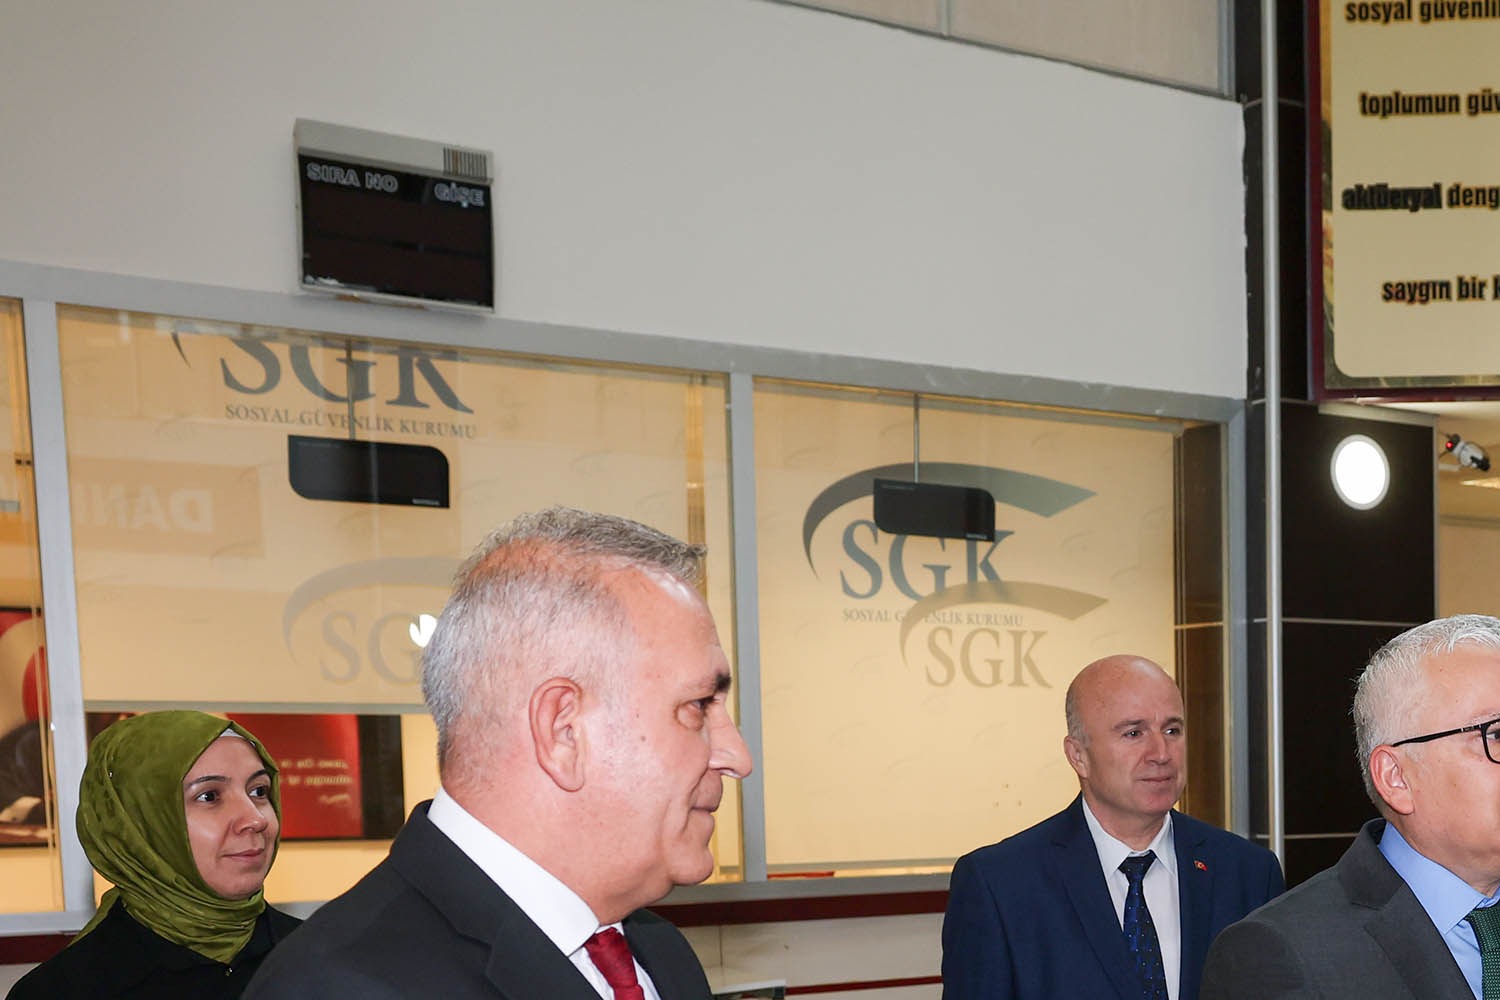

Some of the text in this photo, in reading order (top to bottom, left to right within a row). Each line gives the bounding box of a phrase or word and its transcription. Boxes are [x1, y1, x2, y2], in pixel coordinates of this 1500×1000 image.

[1346, 0, 1412, 24] sosyal
[1360, 92, 1460, 118] toplumun
[307, 162, 485, 208] SIRA NO GİŞE
[1342, 183, 1442, 213] aktüeryal
[1383, 279, 1452, 305] saygın
[1457, 276, 1487, 301] bir
[225, 404, 477, 440] SOSYAL GÜVENLİK KURUMU
[842, 608, 893, 624] SOSYAL
[966, 613, 1023, 627] KURUMU
[925, 626, 1053, 689] SGK
